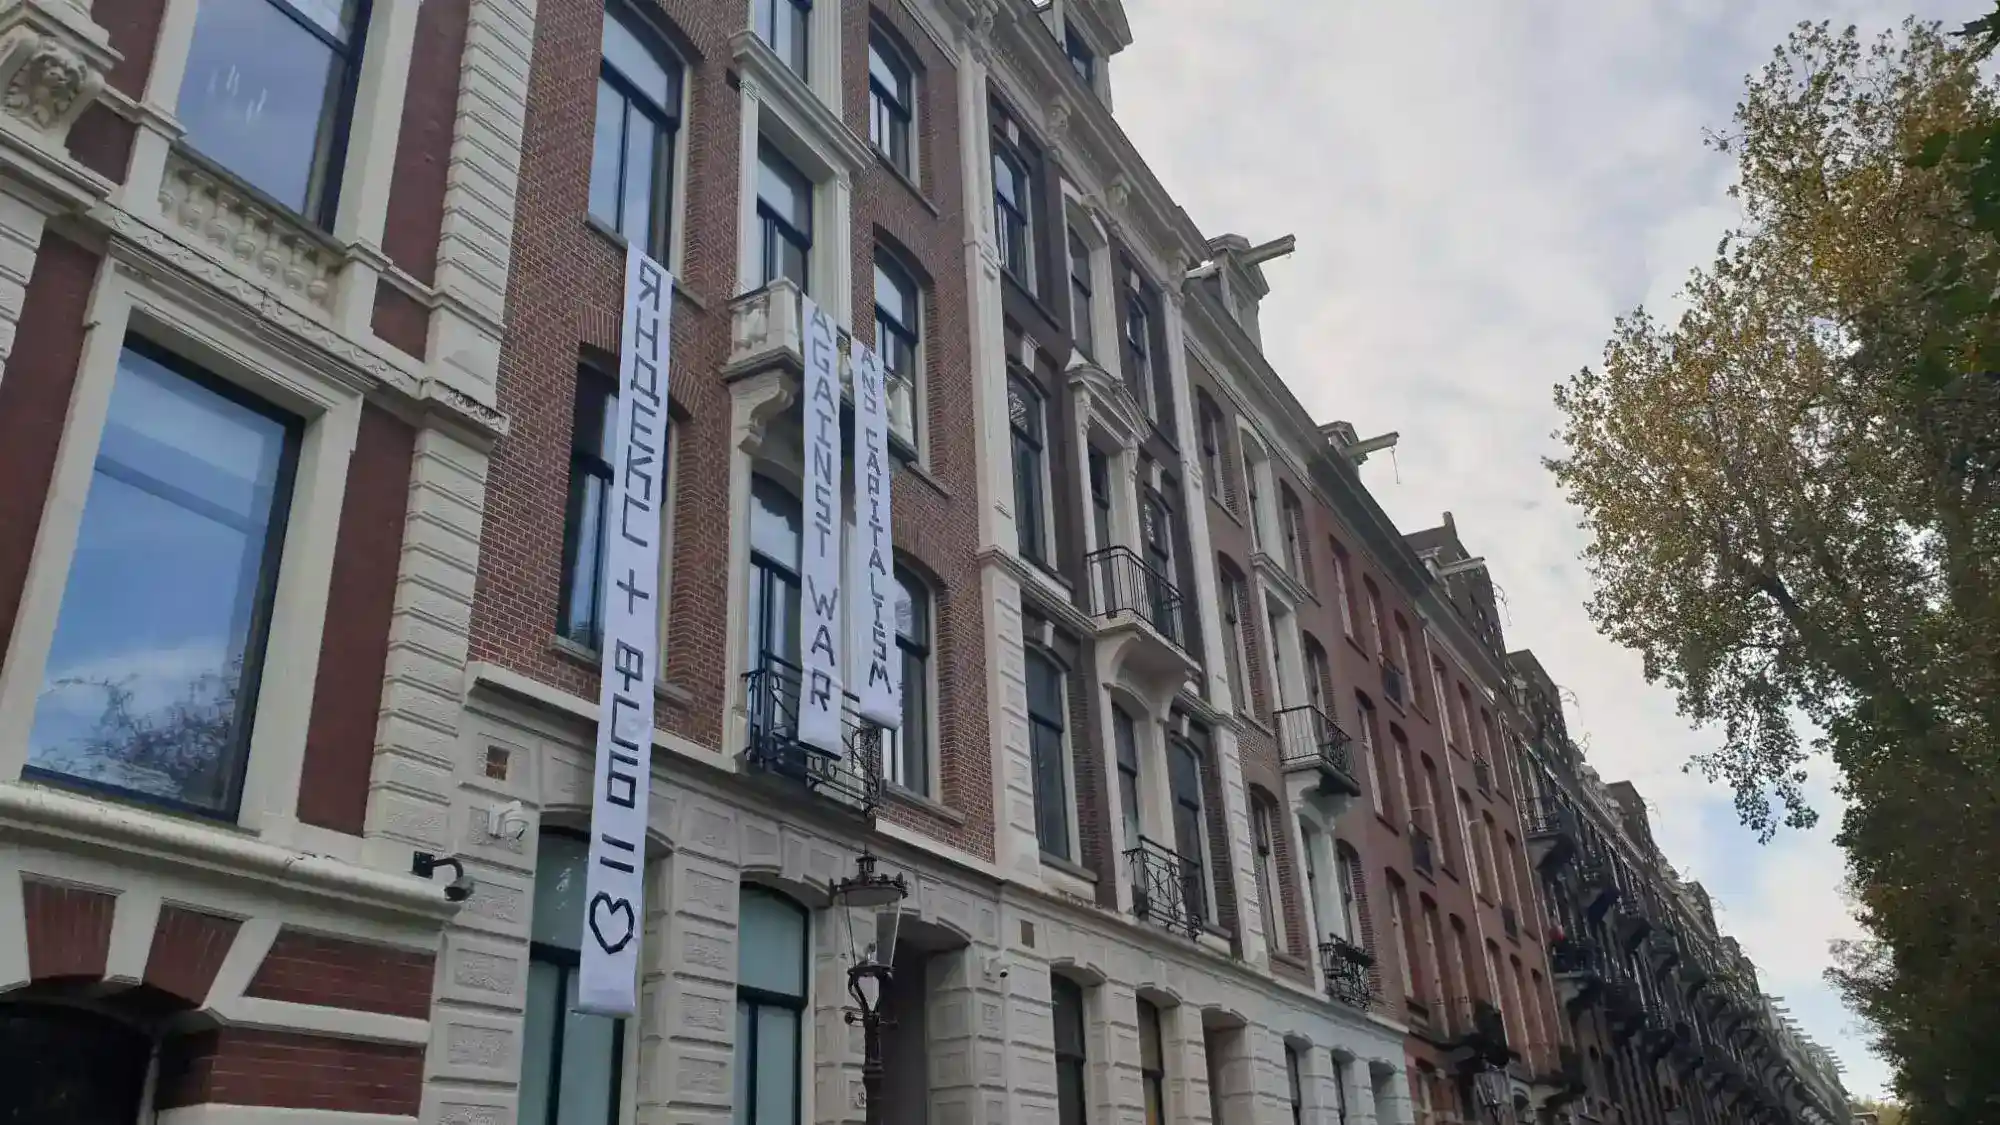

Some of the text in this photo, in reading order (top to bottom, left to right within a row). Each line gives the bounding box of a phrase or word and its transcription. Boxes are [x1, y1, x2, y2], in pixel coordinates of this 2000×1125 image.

[808, 305, 838, 711] AGAINST WAR
[860, 348, 892, 694] AND CAPITALISM
